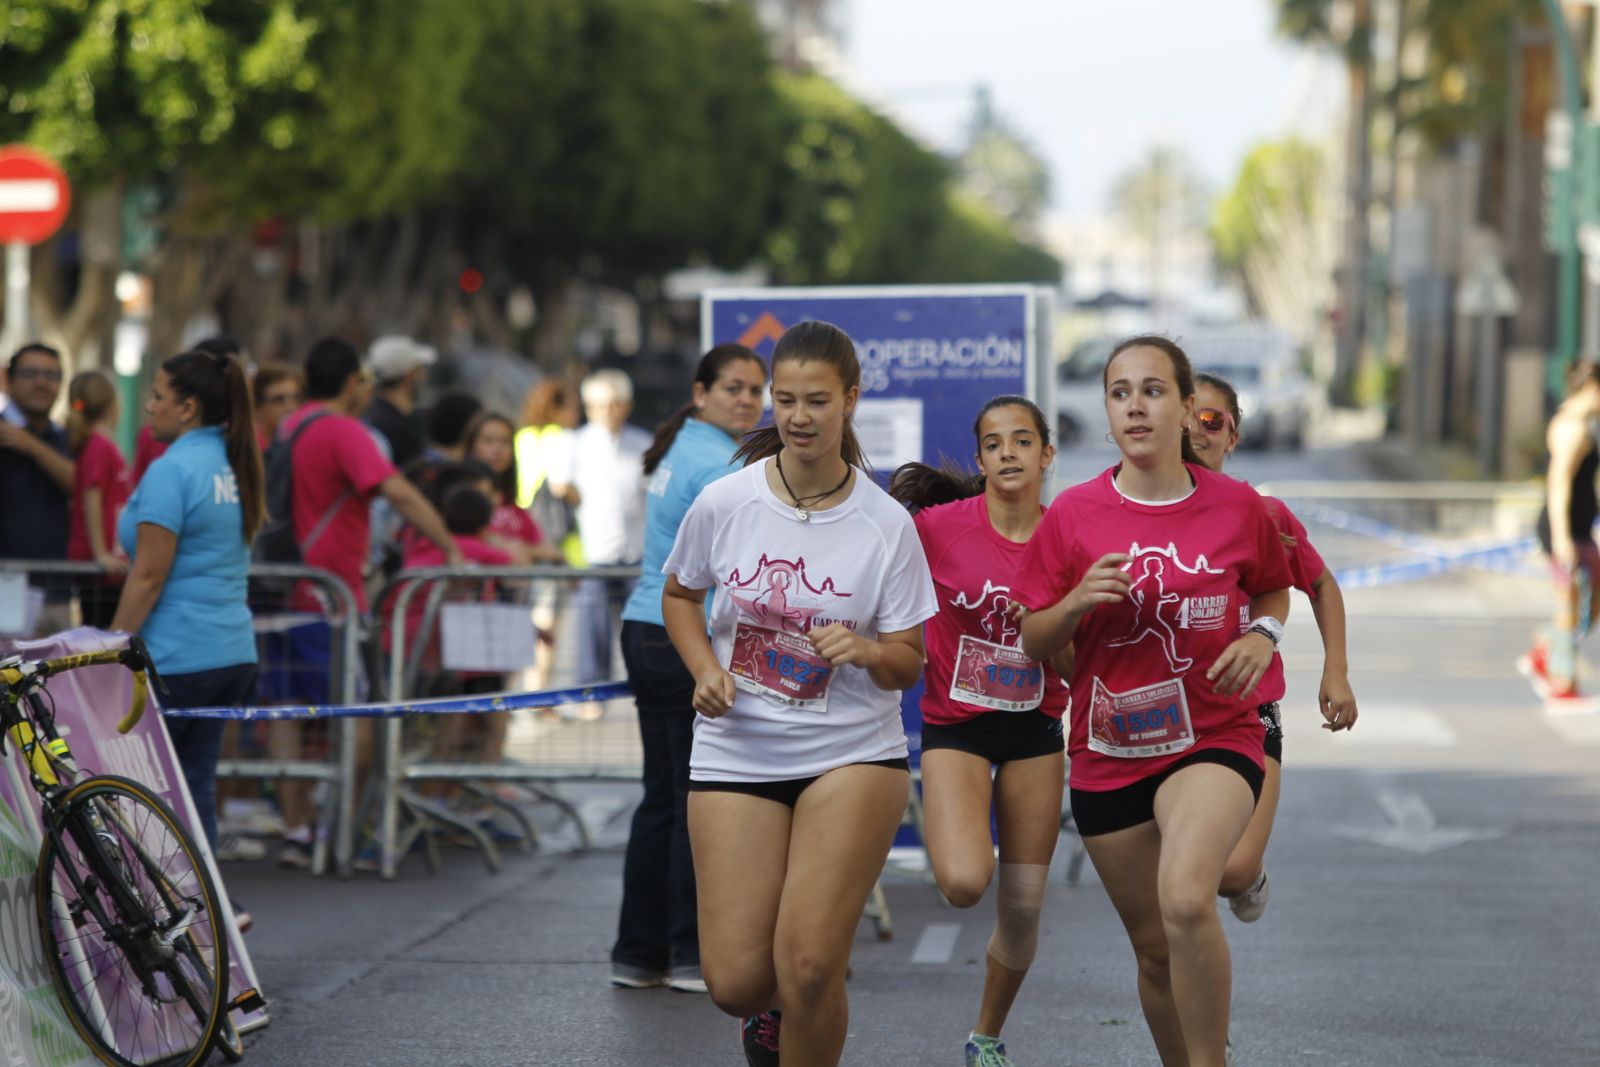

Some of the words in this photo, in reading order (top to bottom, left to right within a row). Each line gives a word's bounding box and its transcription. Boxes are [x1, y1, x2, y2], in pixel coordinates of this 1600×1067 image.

[1175, 597, 1191, 629] 4
[764, 649, 833, 685] 1827
[780, 678, 801, 692] PAULA
[1112, 703, 1181, 733] 1501
